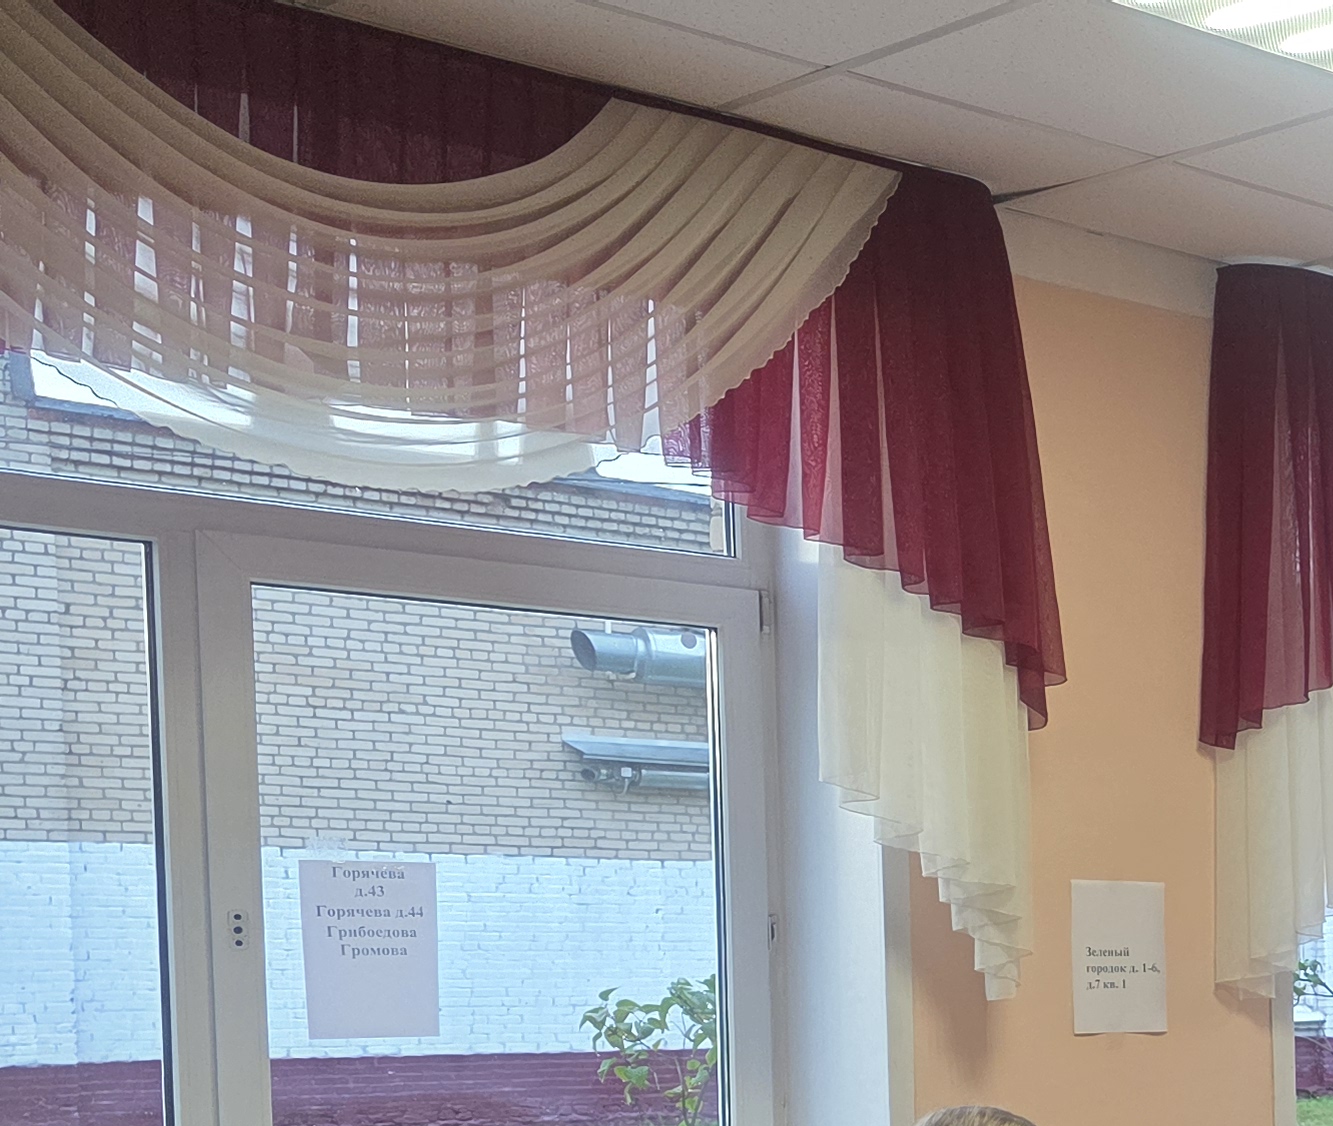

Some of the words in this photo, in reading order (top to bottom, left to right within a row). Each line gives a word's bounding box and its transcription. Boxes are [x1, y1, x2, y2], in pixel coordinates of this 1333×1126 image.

[331, 866, 405, 881] Горячева
[354, 885, 385, 898] д.43
[316, 905, 391, 920] Горячева
[395, 906, 424, 919] д.44
[326, 925, 417, 941] Грибоедова
[340, 944, 408, 959] Громова
[1085, 946, 1130, 957] Зеленый
[1086, 964, 1127, 976] городок
[1128, 964, 1139, 973] д.
[1142, 963, 1161, 974] 1-6,
[1086, 979, 1100, 990] д.7
[1103, 979, 1119, 989] кв.
